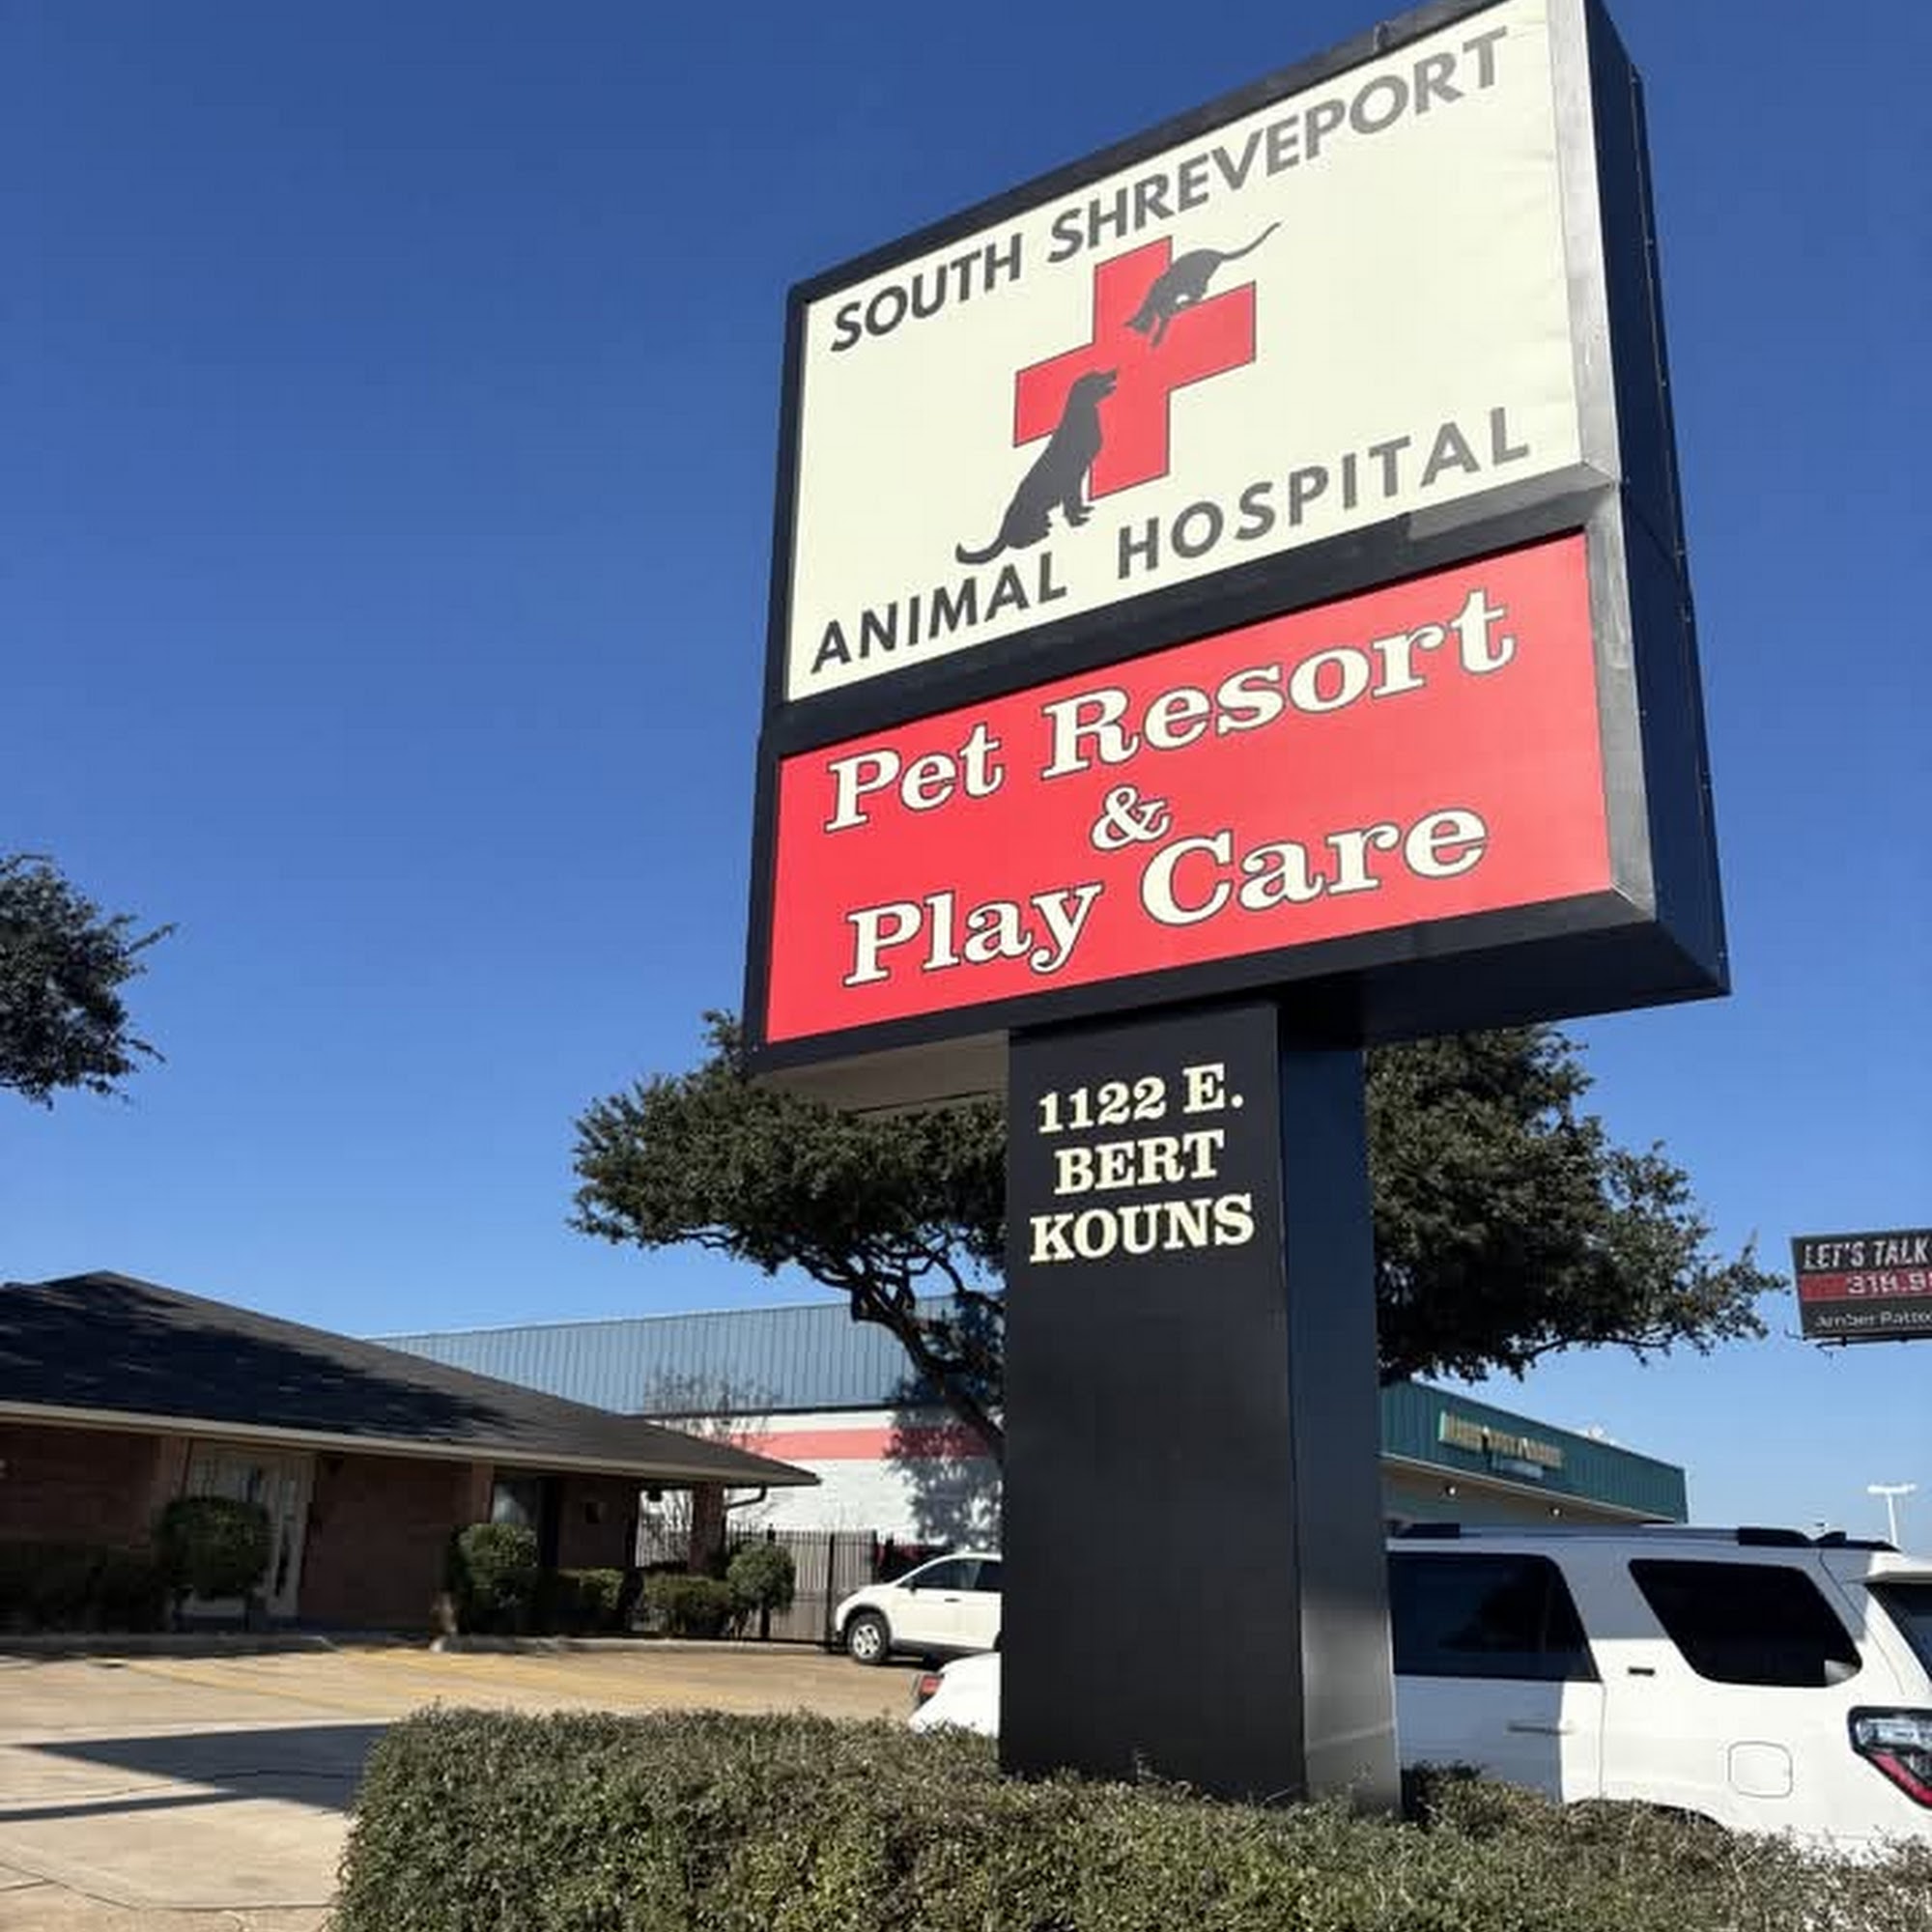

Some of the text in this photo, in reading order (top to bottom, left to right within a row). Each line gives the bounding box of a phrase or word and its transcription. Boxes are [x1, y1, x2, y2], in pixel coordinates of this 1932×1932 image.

[831, 26, 1507, 352] SOUTH SHREVEPORT
[810, 407, 1529, 673] ANIMAL HOSPITAL
[823, 588, 1515, 832] Pet Resort
[1091, 785, 1171, 851] &
[842, 807, 1489, 987] Play Care
[1038, 1063, 1244, 1134] 1122 E.
[1054, 1128, 1225, 1195] BERT
[1030, 1192, 1255, 1263] KOUNS
[1804, 1236, 1928, 1270] LET'S TALK
